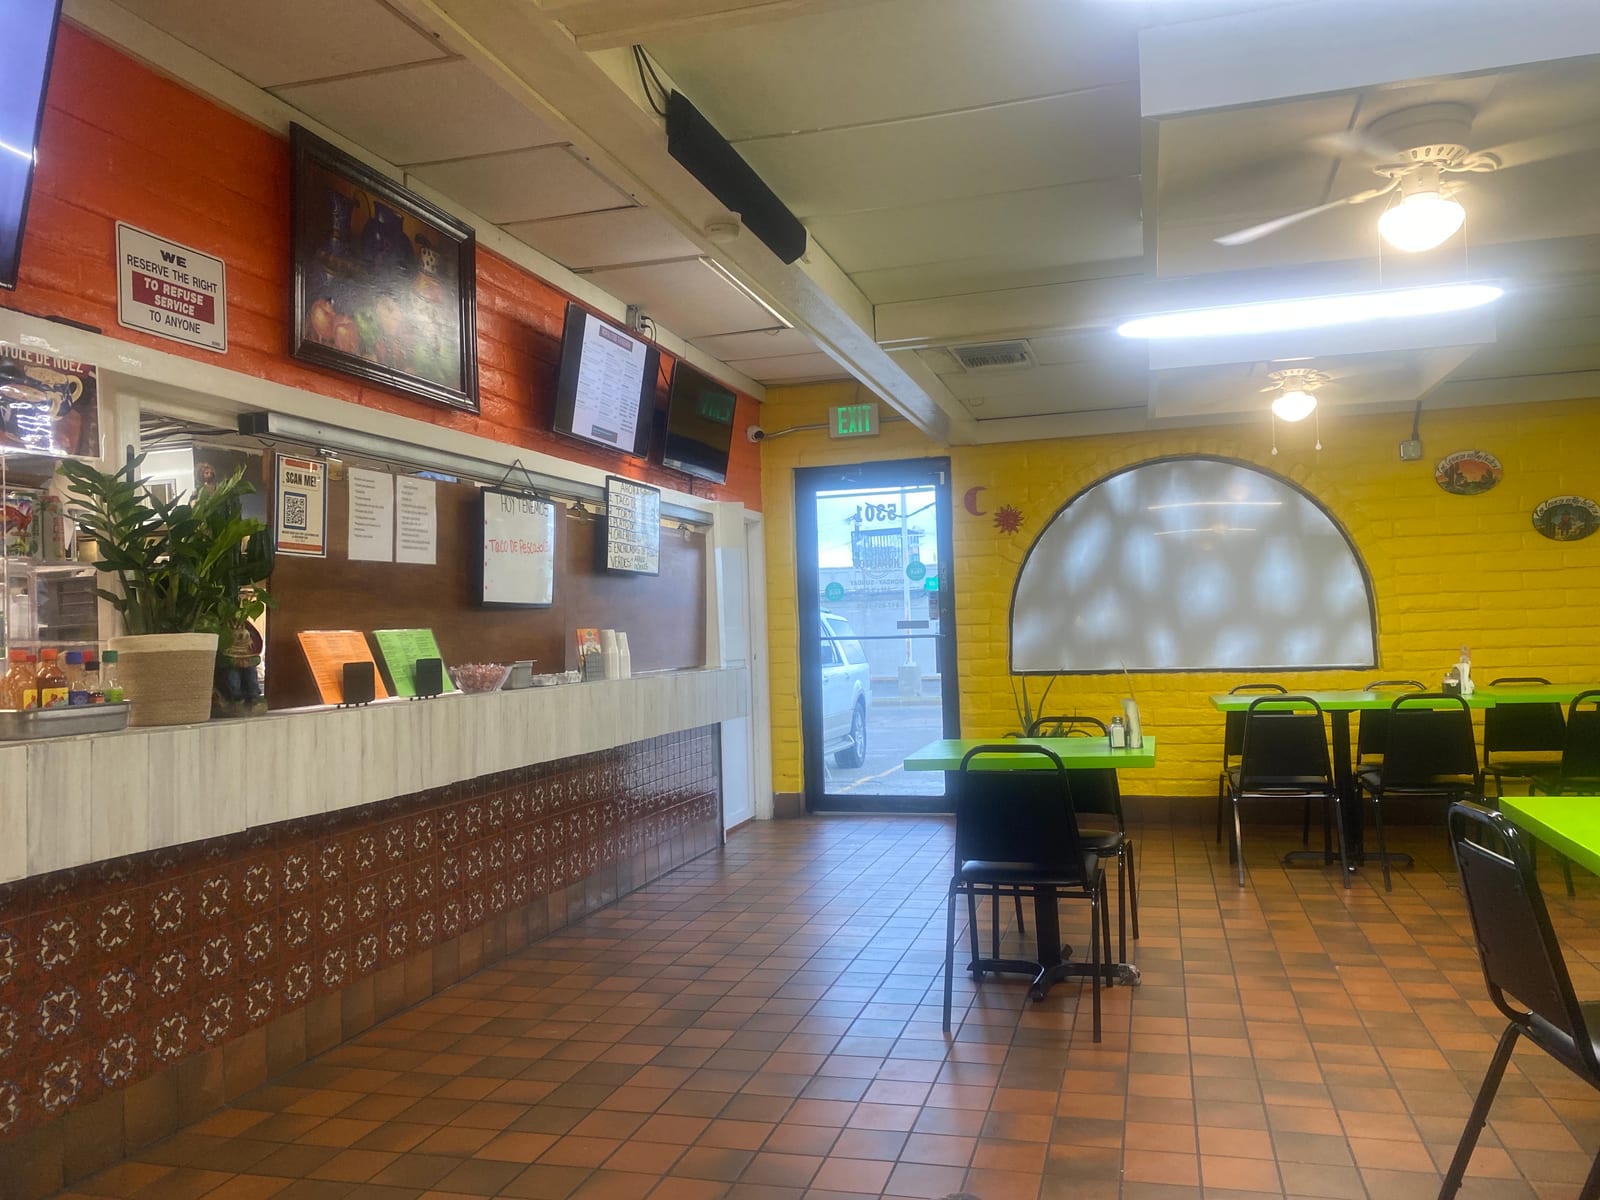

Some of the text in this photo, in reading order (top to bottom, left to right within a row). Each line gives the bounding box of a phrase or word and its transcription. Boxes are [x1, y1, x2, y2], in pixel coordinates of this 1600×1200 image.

[160, 249, 187, 269] WE
[127, 254, 218, 294] RESERVE THE RIGHT
[144, 277, 204, 306] TO REFUSE
[154, 294, 195, 317] SERVICE
[149, 309, 201, 335] TO ANYONE
[36, 353, 51, 367] DE
[837, 405, 872, 434] EXIT
[286, 471, 317, 488] SCAN ME!
[500, 495, 515, 517] HOY
